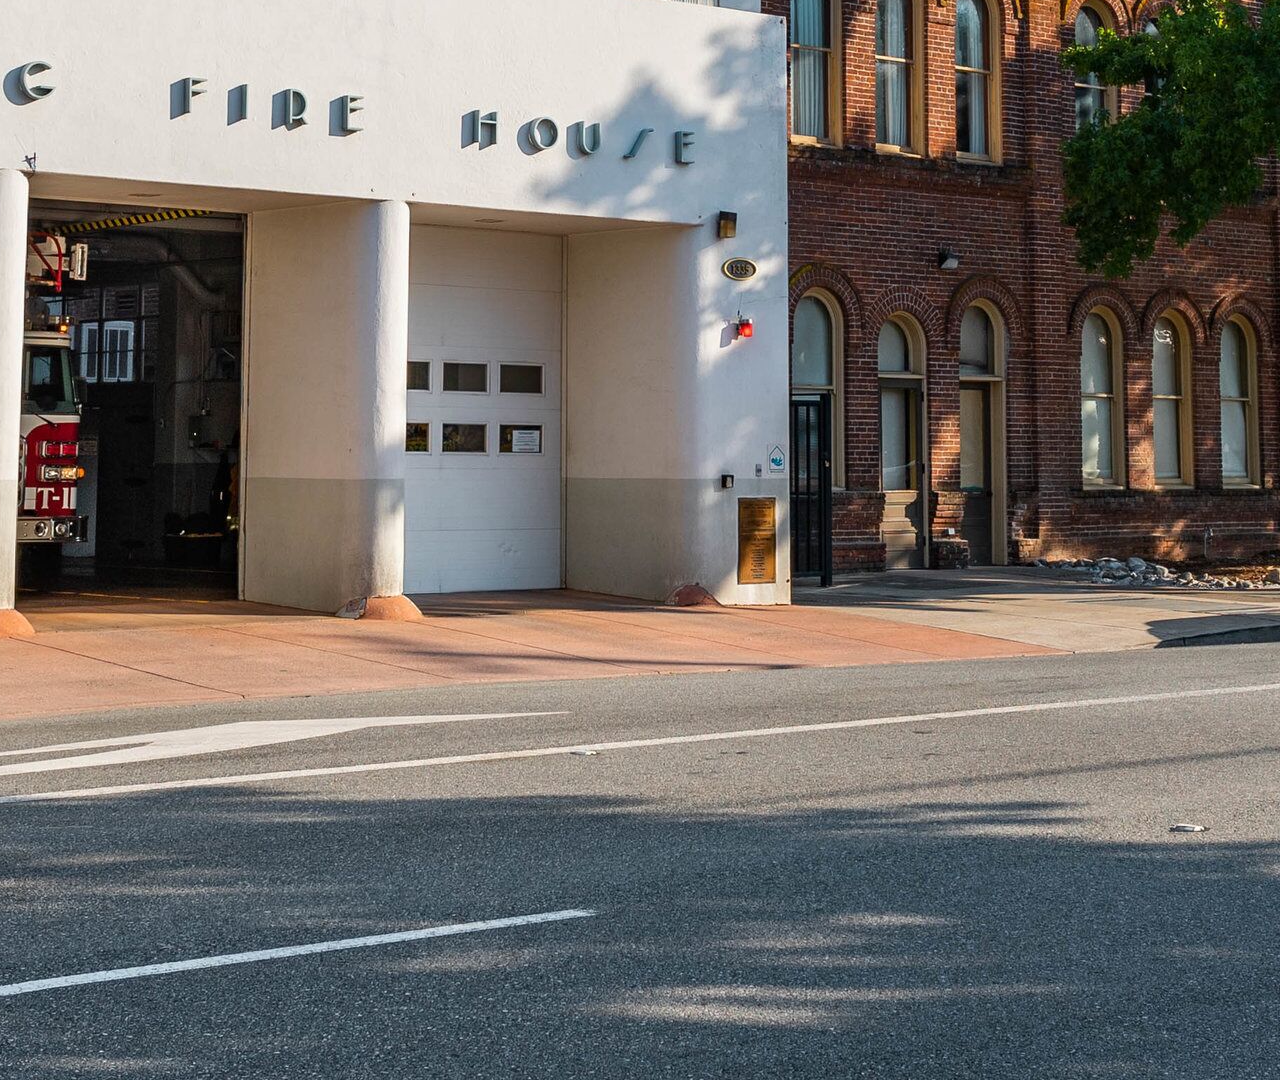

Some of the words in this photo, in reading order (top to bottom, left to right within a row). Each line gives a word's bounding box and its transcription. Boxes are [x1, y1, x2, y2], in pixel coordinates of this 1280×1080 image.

[179, 76, 365, 134] FIRE
[470, 109, 696, 165] HOUSE
[730, 264, 754, 276] 1335
